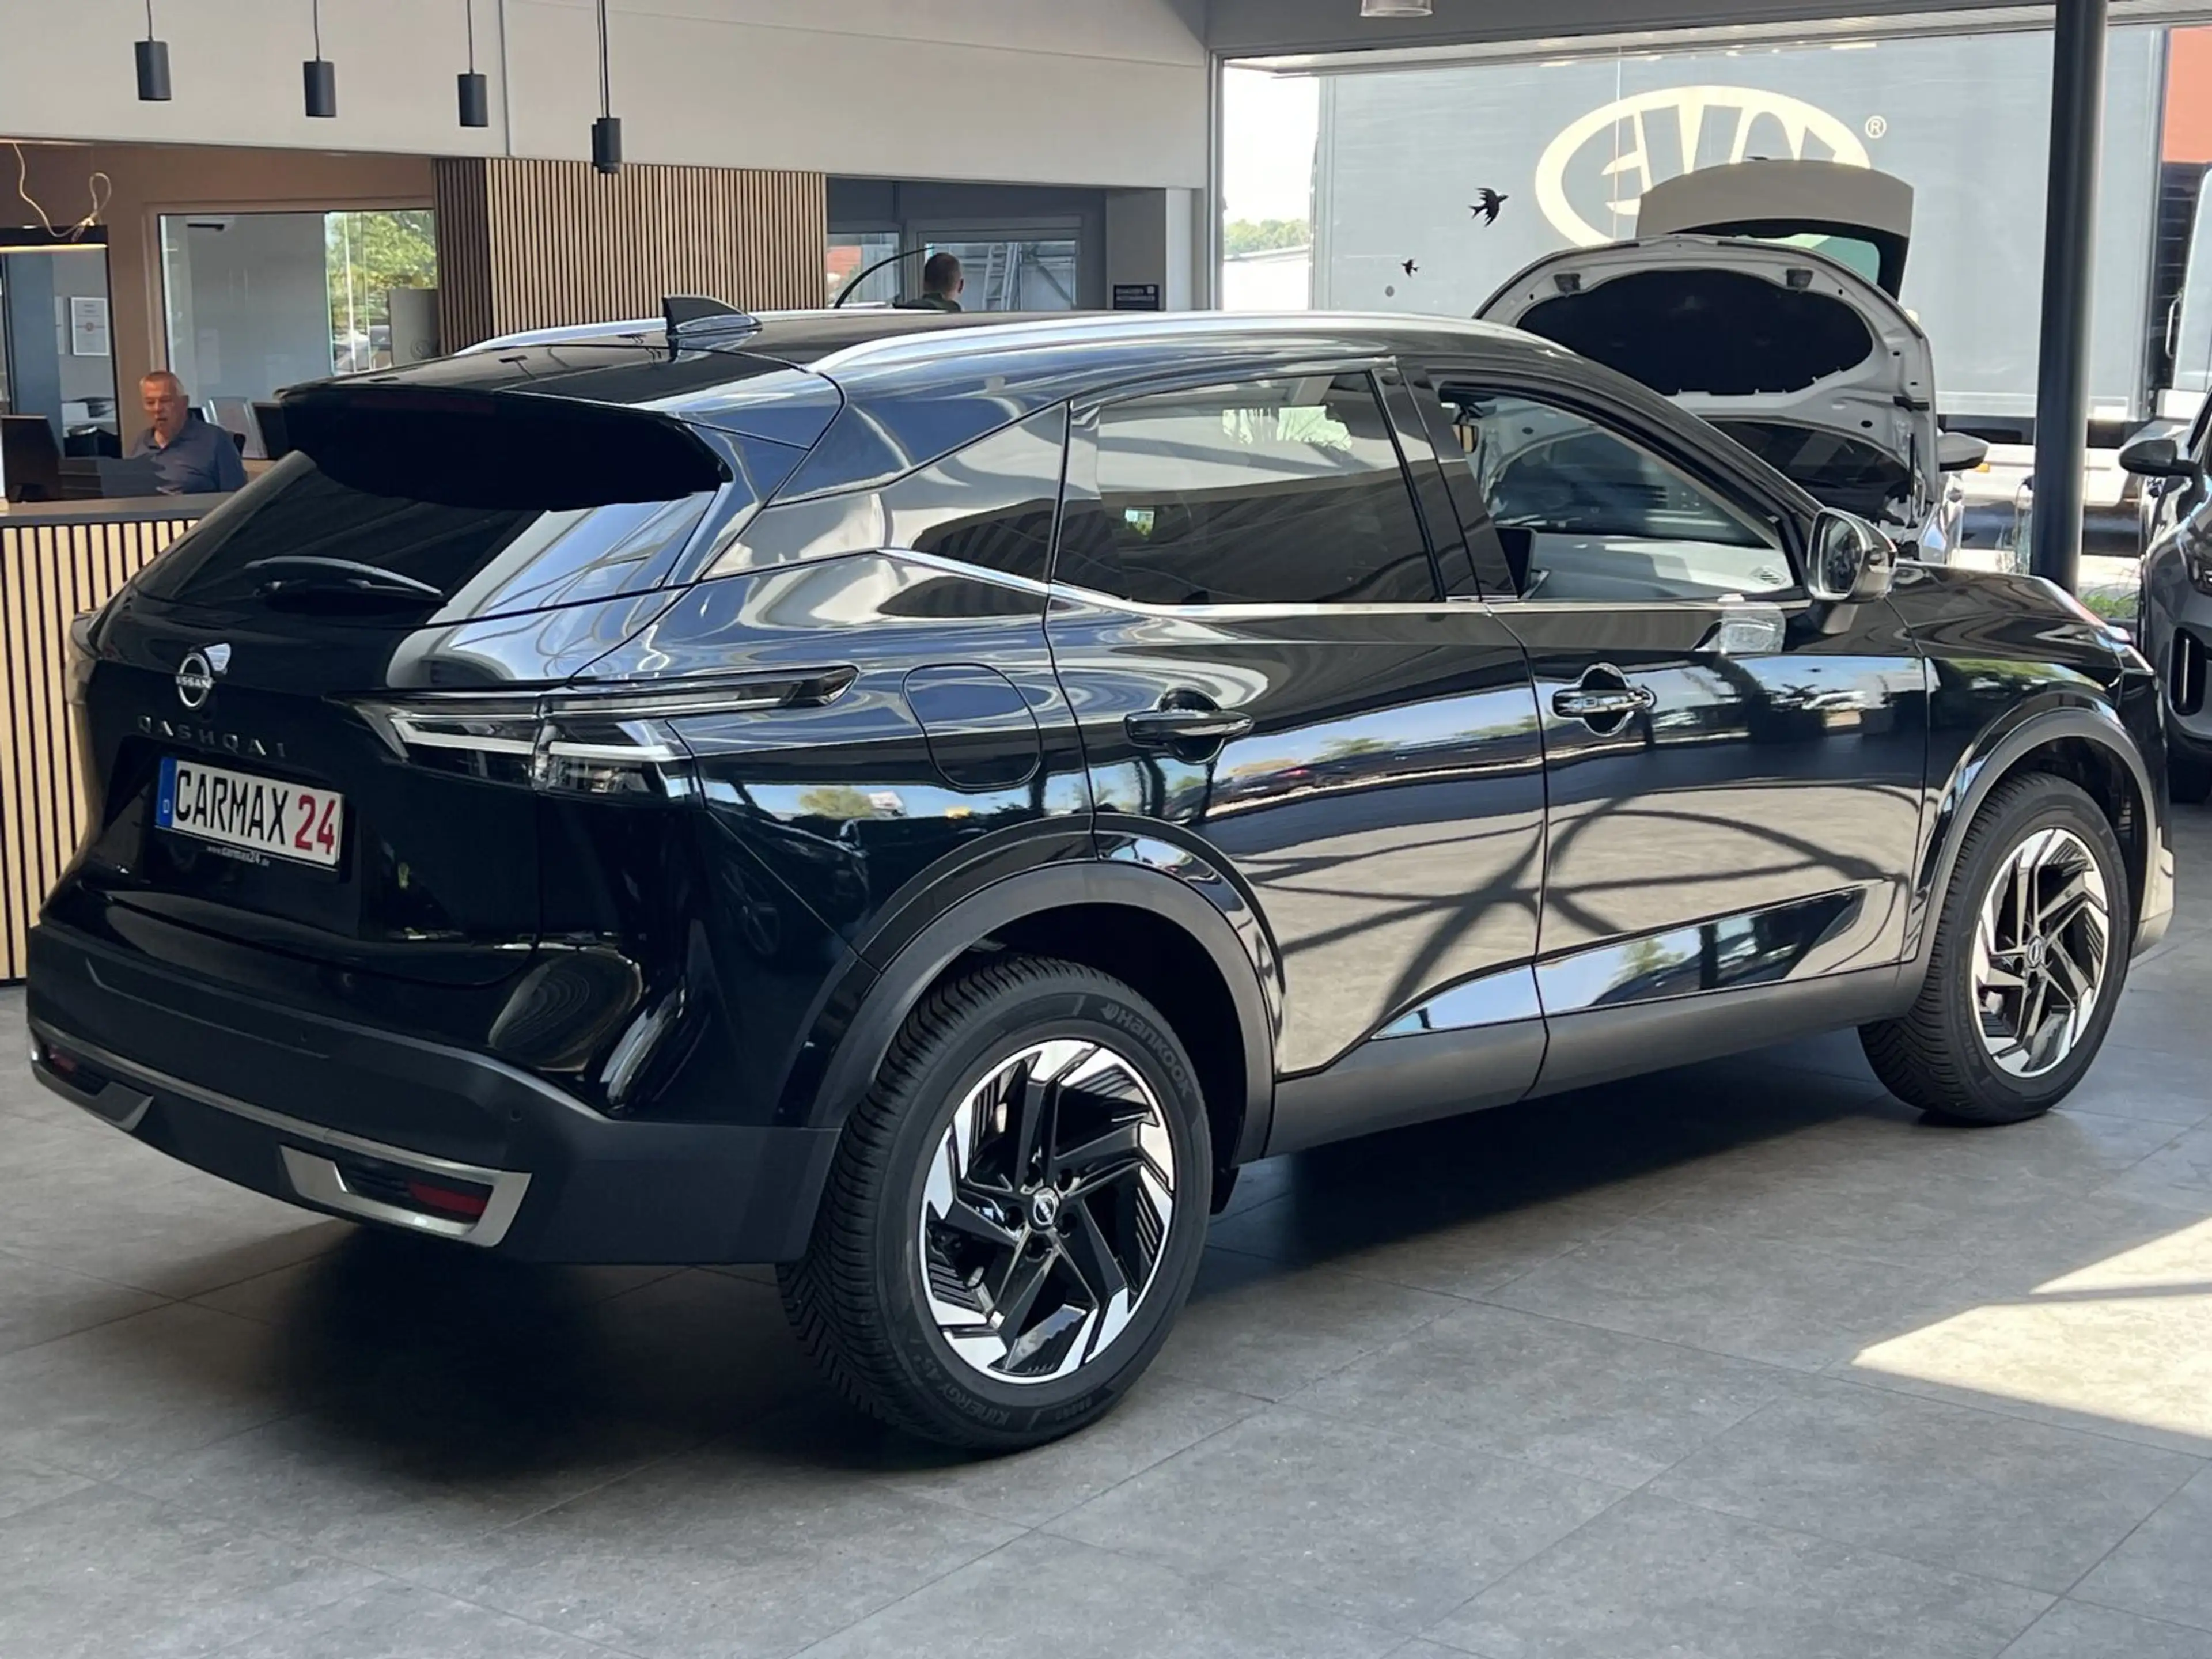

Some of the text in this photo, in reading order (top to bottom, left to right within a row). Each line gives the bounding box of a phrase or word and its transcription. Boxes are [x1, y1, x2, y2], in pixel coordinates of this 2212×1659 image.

[175, 675, 213, 690] NISSAN
[137, 714, 286, 758] QASHQAI
[175, 769, 336, 855] CARMAX 24
